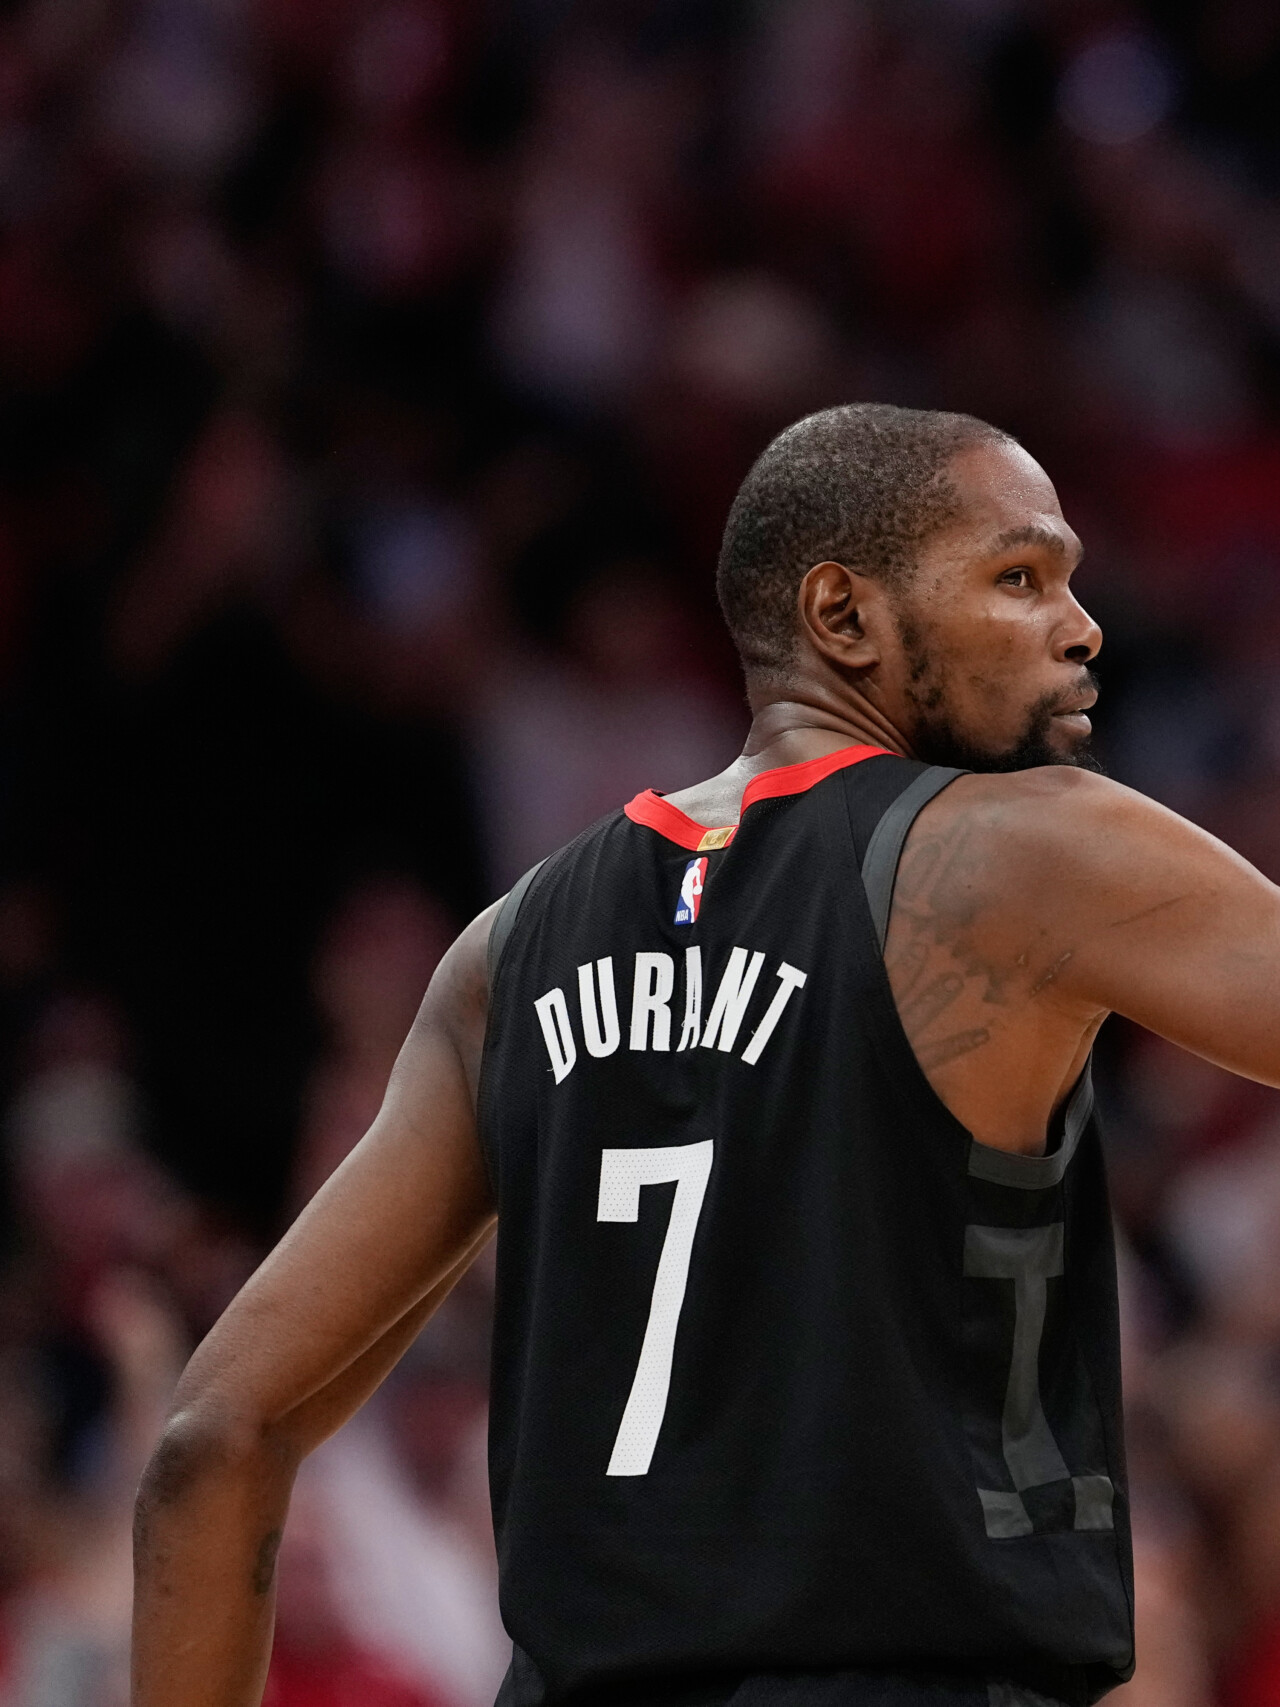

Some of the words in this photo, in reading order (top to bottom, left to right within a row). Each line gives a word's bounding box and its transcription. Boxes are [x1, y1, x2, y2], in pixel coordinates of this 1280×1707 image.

[675, 909, 689, 922] NBA
[533, 945, 808, 1085] DURANT
[597, 1139, 714, 1476] 7
